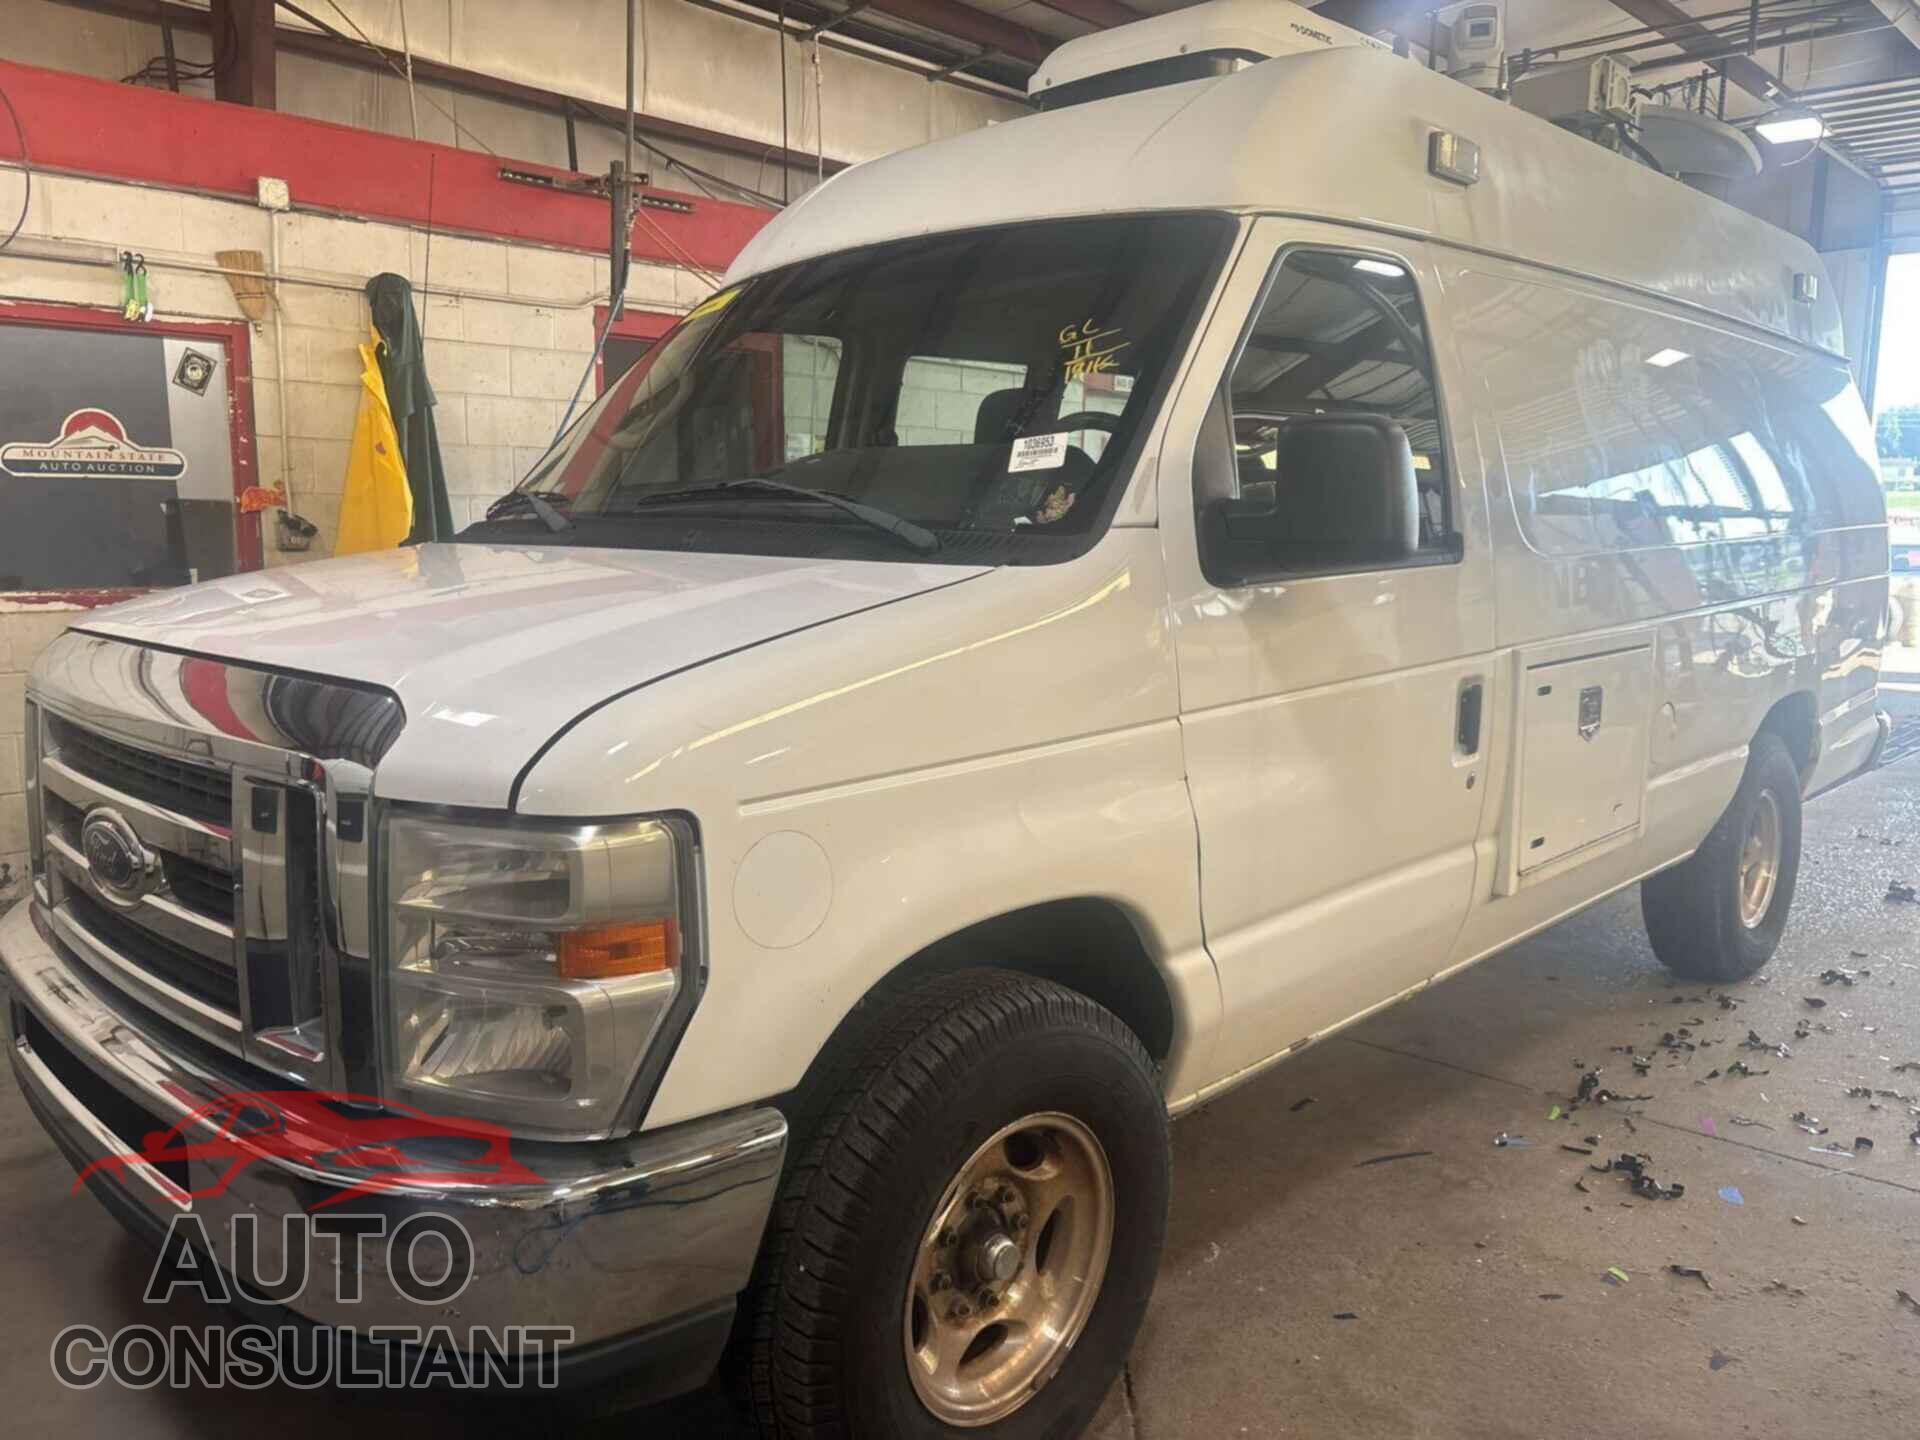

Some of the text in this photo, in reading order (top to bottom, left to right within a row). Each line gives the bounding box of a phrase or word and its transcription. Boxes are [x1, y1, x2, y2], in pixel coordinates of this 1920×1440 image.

[22, 449, 168, 462] MOUNTAIN STATE
[39, 462, 156, 473] AUTO AUCTION
